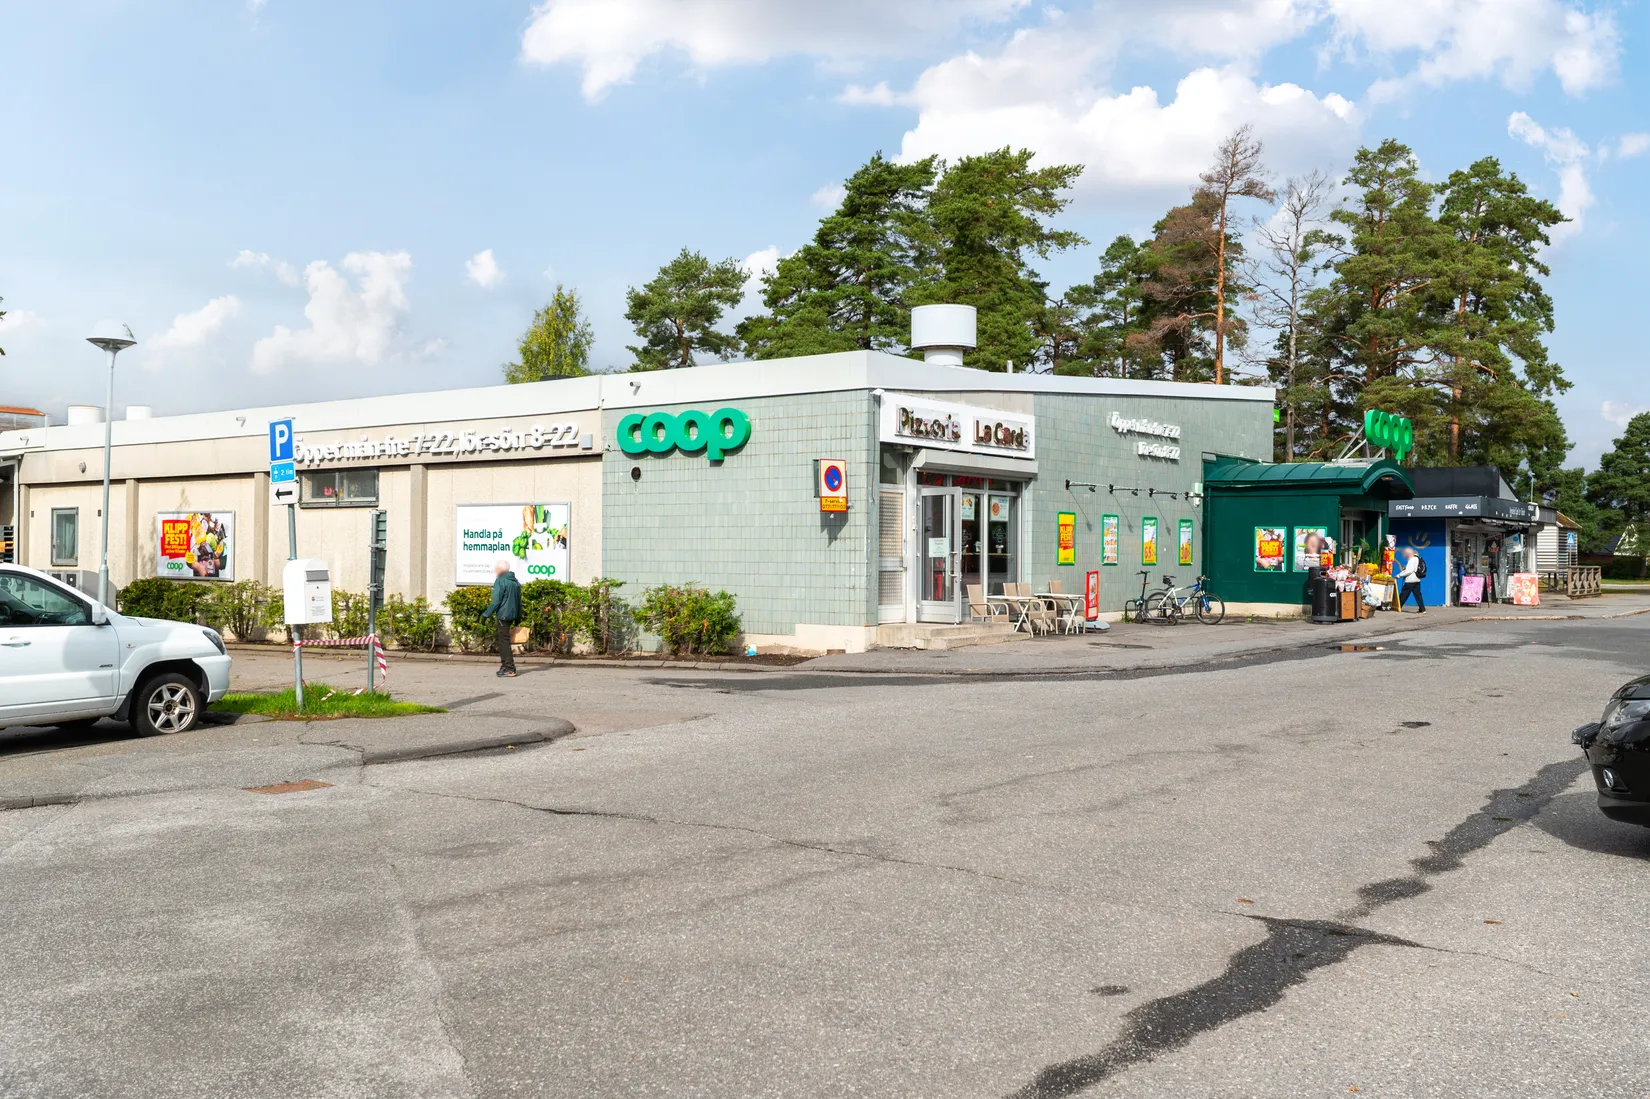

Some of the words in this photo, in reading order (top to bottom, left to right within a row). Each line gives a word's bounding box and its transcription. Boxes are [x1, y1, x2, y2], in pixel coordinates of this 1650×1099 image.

[530, 422, 580, 448] 8-22
[616, 407, 751, 461] coop
[974, 419, 992, 443] La
[1365, 409, 1413, 460] coop
[275, 424, 289, 458] P
[164, 522, 189, 534] KLIPP
[463, 529, 491, 539] Handla
[492, 528, 503, 541] på
[165, 533, 187, 545] FEST!
[463, 541, 511, 553] hemmaplan
[167, 562, 184, 571] coop
[528, 564, 556, 577] coop
